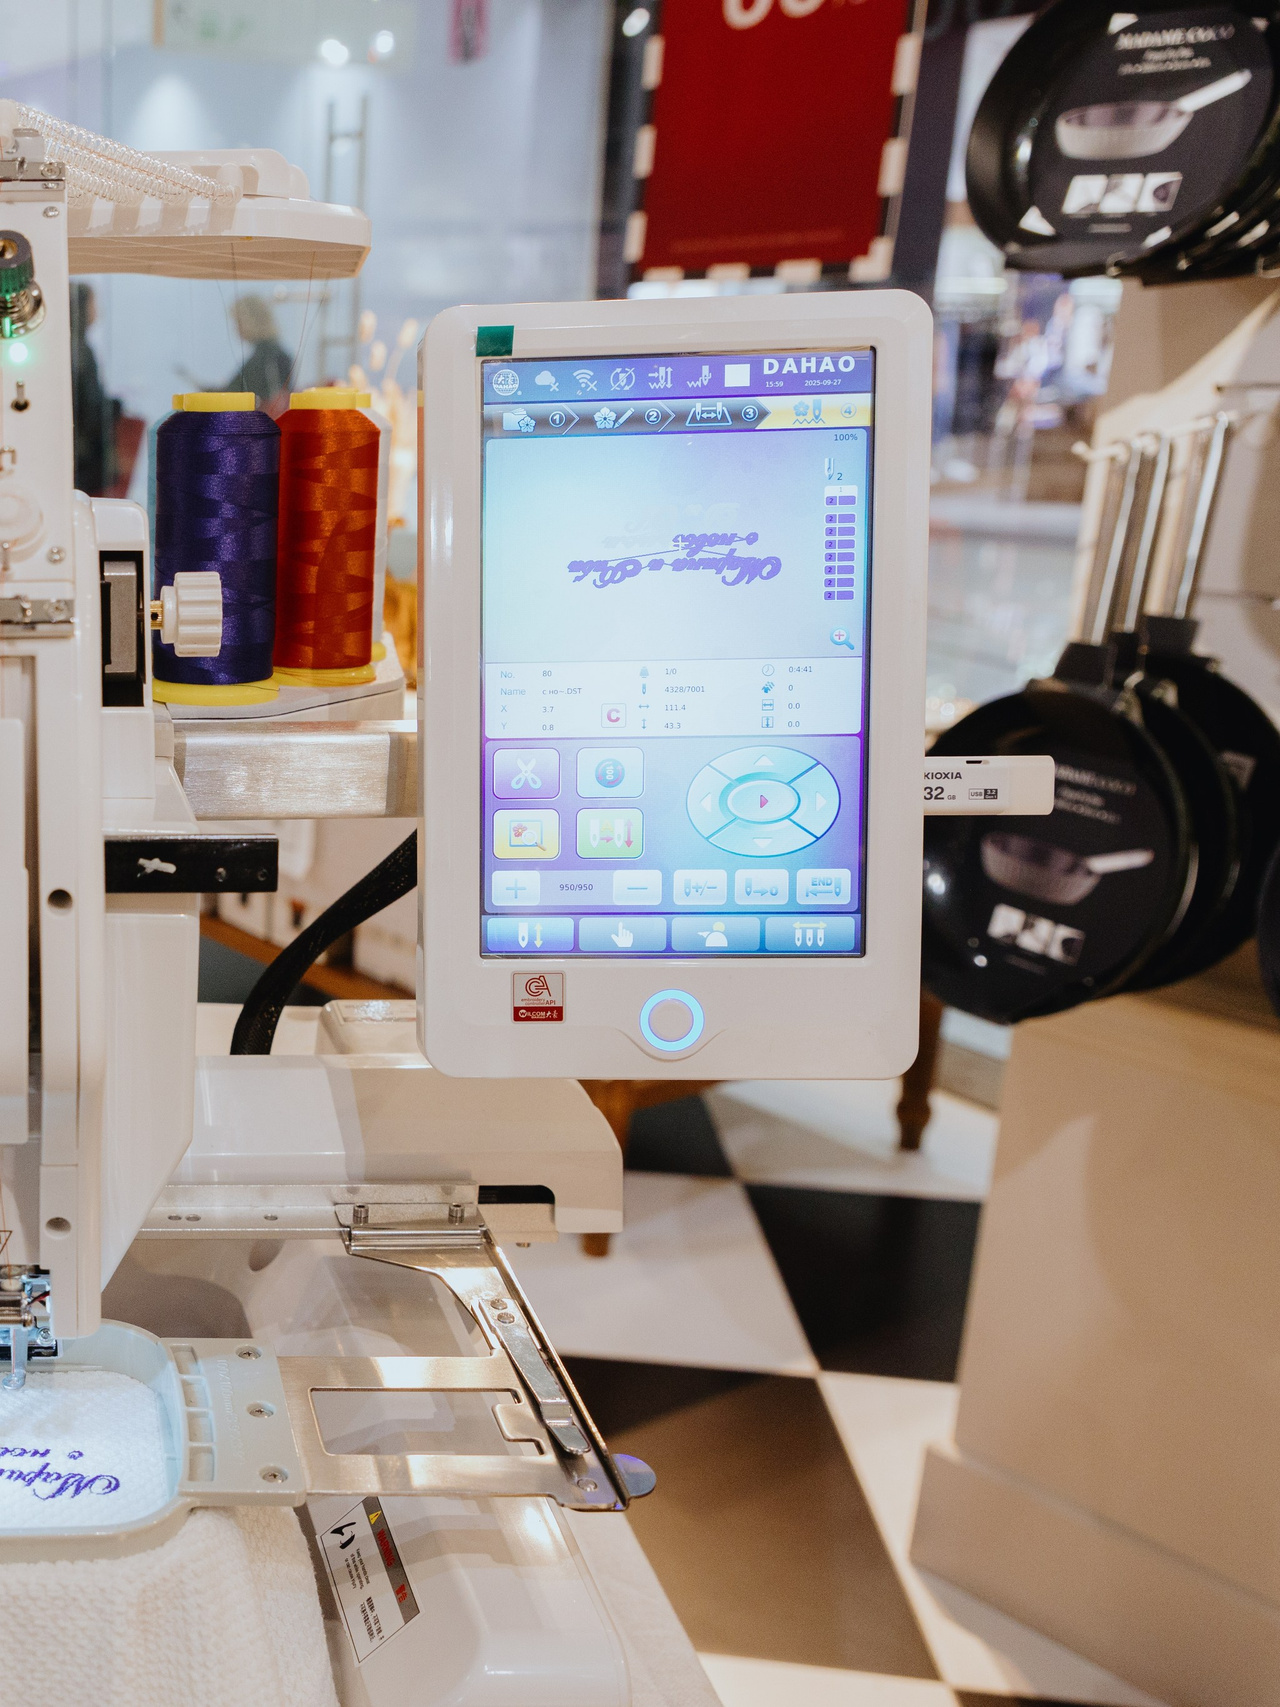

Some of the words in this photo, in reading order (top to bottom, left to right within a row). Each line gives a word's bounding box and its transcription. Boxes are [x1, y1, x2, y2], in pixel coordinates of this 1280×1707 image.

[763, 355, 855, 375] DAHAO
[765, 380, 784, 388] 15:59
[804, 379, 842, 387] 2025-09-27
[834, 433, 858, 441] 100%
[837, 472, 843, 481] 2
[500, 671, 515, 679] No.
[665, 667, 677, 675] 1/0
[500, 688, 526, 696] Name
[664, 685, 705, 693] 4328/7001
[788, 702, 801, 710] 0.0
[501, 722, 507, 730] Y
[664, 722, 682, 730] 43.3
[787, 720, 800, 728] 0.0
[923, 771, 963, 780] KIOXIA
[923, 785, 945, 801] 32
[811, 876, 833, 887] END
[559, 883, 594, 892] 950/950
[377, 1528, 395, 1567] WARNING
